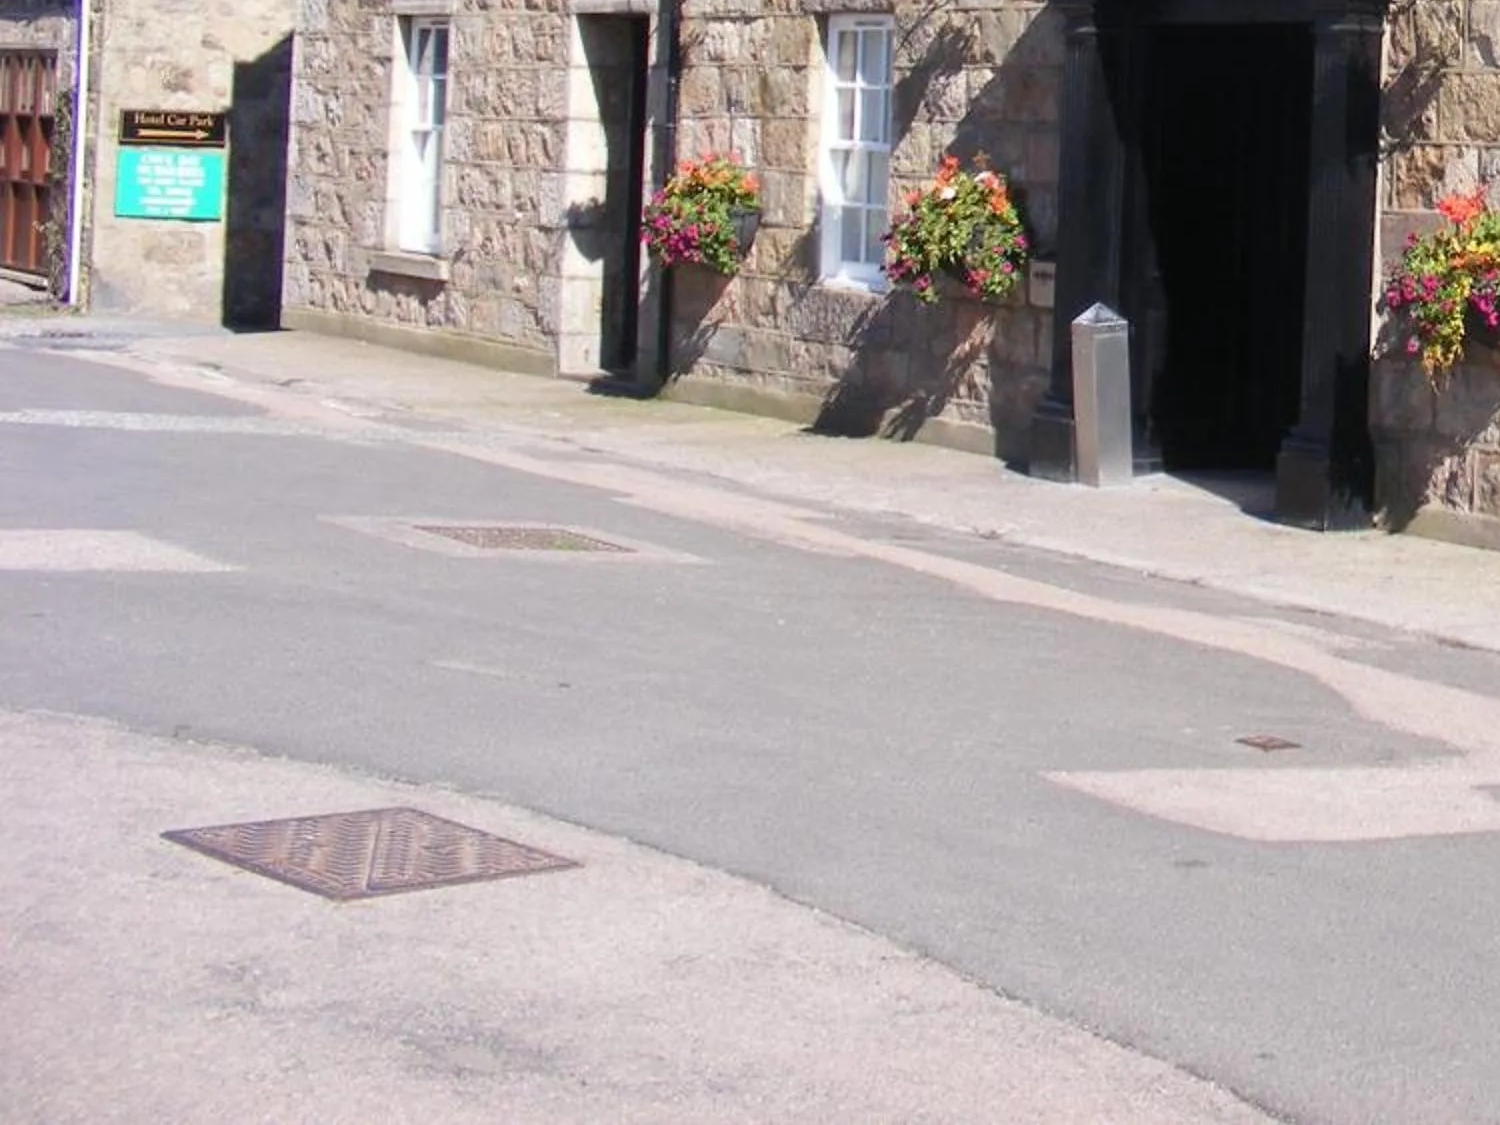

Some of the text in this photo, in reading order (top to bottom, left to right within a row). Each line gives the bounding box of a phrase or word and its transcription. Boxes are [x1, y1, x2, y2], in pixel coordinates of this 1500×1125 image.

[134, 112, 214, 127] Hotel Car Park
